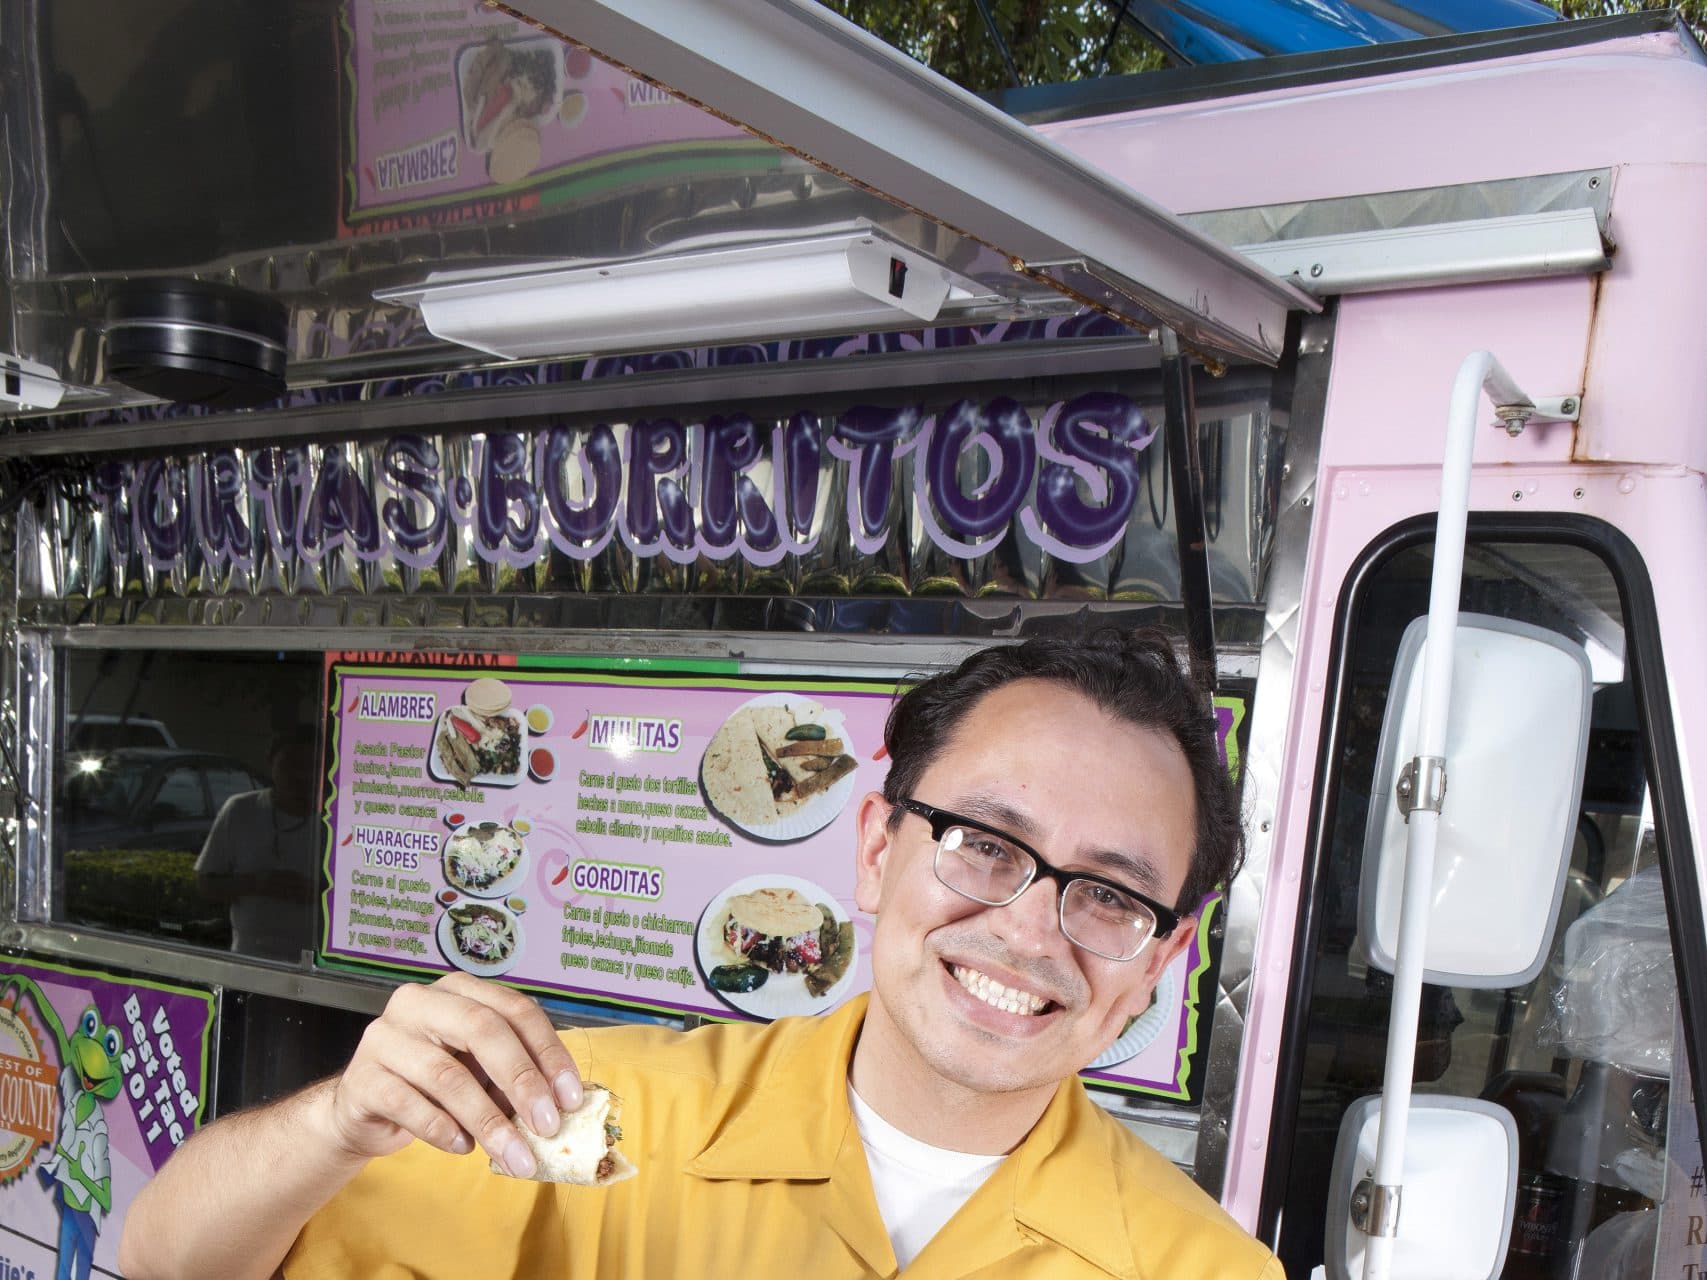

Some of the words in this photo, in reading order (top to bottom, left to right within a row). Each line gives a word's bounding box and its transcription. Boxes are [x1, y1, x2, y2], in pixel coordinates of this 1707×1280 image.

[470, 391, 1160, 569] BURRITOS
[360, 694, 435, 720] ALAMBRES
[578, 769, 605, 788] Carne
[606, 772, 616, 789] al
[616, 773, 642, 794] gusto
[643, 774, 661, 792] dos
[663, 775, 698, 796] tortillas
[577, 792, 608, 812] hechas
[675, 804, 708, 820] oaxaca
[356, 827, 439, 851] HUARACHES
[643, 825, 650, 843] y
[364, 848, 373, 863] Y
[375, 849, 418, 869] SOPES
[351, 869, 384, 888] Carne
[386, 874, 396, 889] al
[398, 878, 431, 894] gusto
[573, 864, 661, 896] GORDITAS
[563, 901, 591, 921] Carne
[593, 906, 602, 923] al
[603, 910, 631, 928] gusto
[348, 930, 356, 946] y
[560, 952, 589, 970] queso
[625, 962, 633, 979] y
[633, 963, 664, 981] queso
[25, 1065, 42, 1078] OF
[123, 992, 160, 1078] Best
[154, 1078, 185, 1147] Tac
[152, 1005, 199, 1118] Voted
[1, 1072, 57, 1132] COUNTY
[120, 1048, 163, 1143] 2011
